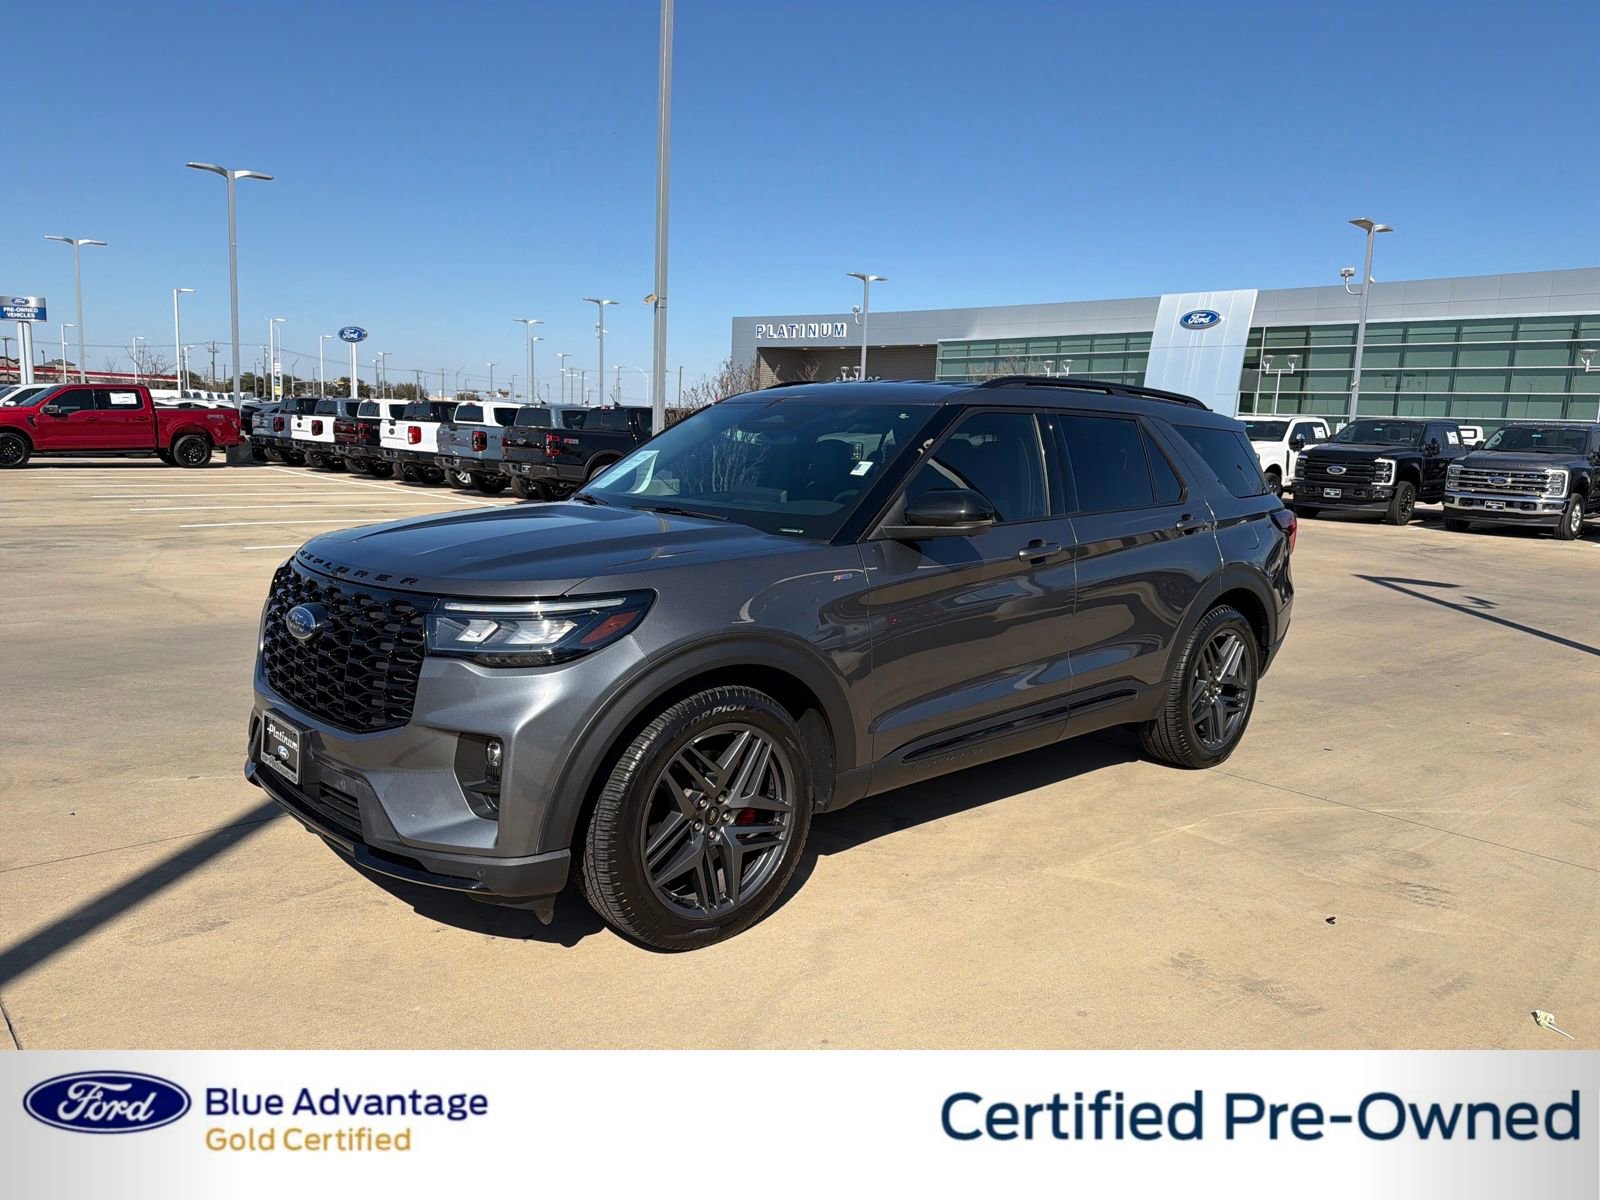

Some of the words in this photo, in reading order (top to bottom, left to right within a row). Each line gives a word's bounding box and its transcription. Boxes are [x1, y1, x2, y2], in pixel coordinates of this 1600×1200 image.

[1188, 313, 1211, 324] Ford
[756, 322, 847, 339] PLATINUM
[300, 550, 419, 585] EXPLORER
[266, 723, 299, 752] Platinum
